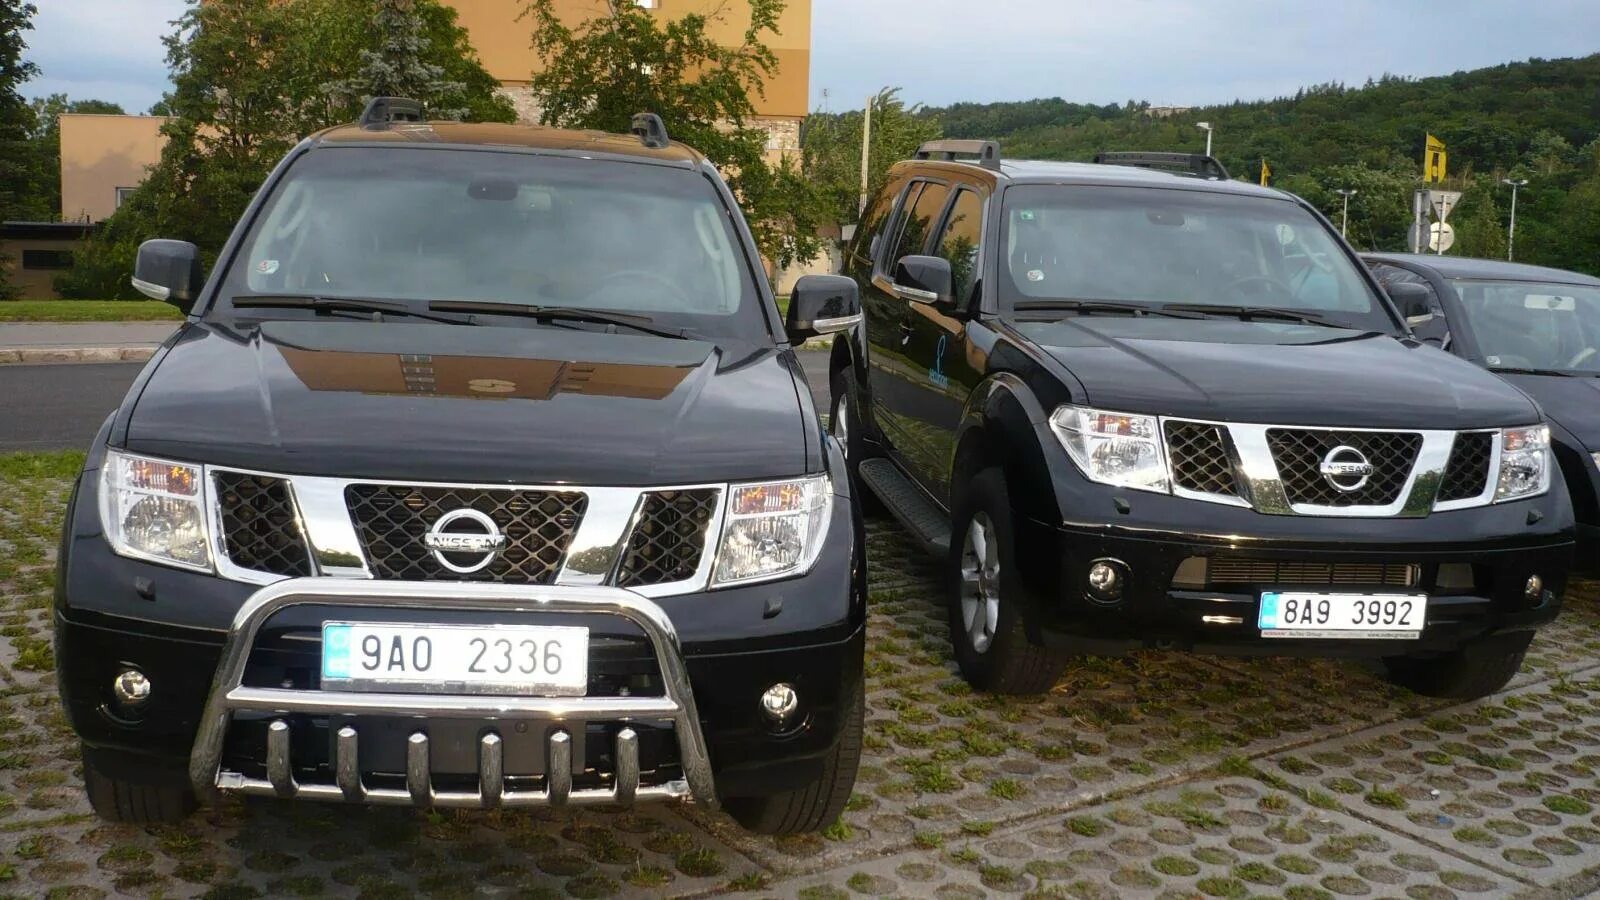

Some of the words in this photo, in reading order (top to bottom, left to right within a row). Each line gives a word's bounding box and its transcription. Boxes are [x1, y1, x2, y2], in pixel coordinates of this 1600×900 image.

[432, 536, 498, 550] NISSAN
[1284, 599, 1331, 624] 8A9
[1351, 600, 1413, 626] 3992
[361, 634, 433, 672] 9A0
[467, 637, 563, 675] 2336
